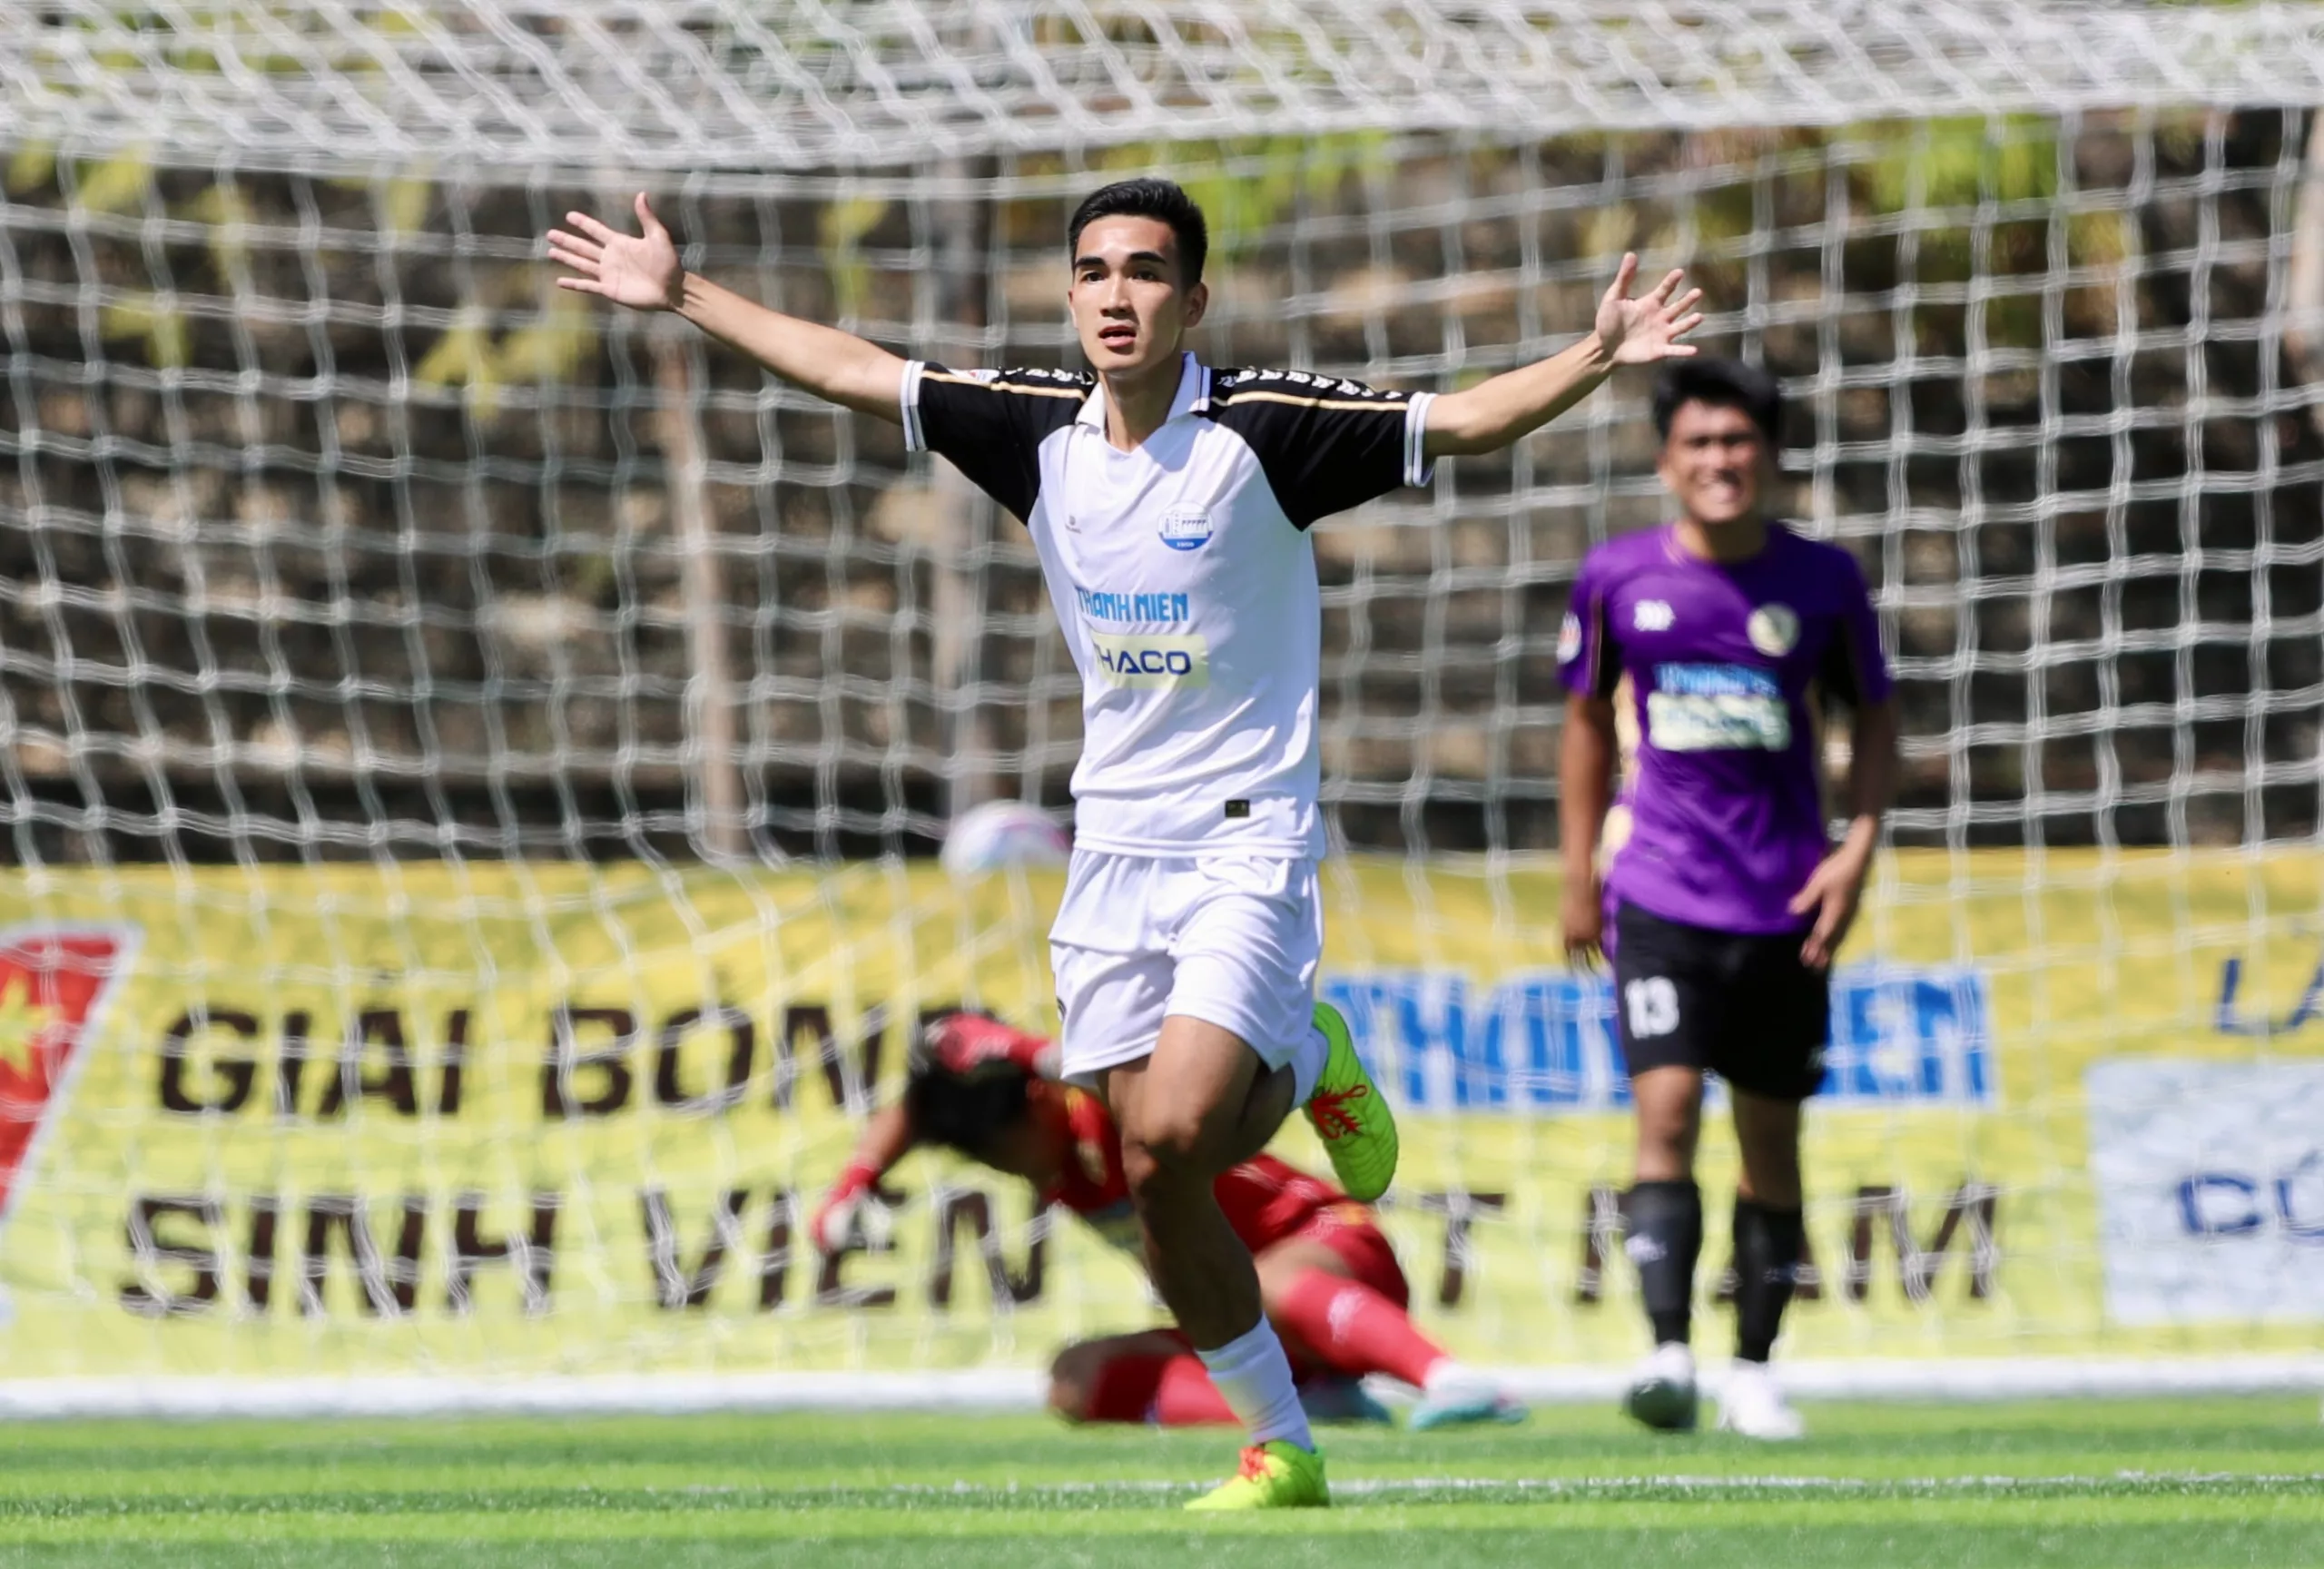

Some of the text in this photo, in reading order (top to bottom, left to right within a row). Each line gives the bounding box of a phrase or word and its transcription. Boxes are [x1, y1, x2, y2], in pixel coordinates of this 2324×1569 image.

[1092, 641, 1192, 676] HACO
[1625, 976, 1679, 1040] 13
[122, 1191, 560, 1317] SINH
